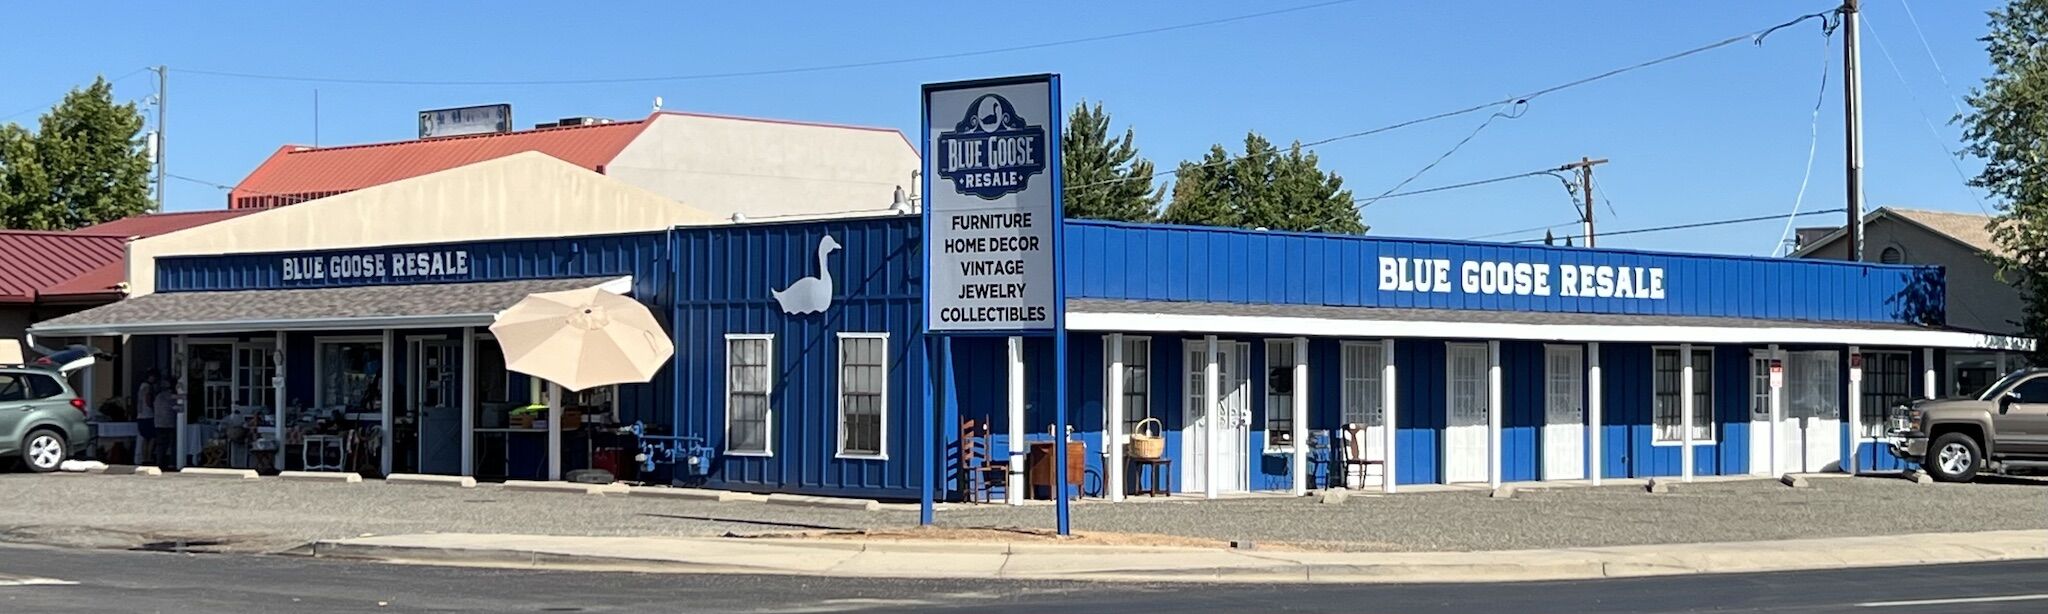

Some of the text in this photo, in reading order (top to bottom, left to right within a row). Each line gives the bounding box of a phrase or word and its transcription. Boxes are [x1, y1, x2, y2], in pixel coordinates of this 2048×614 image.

[948, 136, 1034, 172] BLUE GOOSE
[965, 172, 1018, 188] RESALE
[952, 212, 1032, 230] FURNITURE
[944, 236, 1039, 253] HOME DECOR
[283, 250, 468, 280] BLUE GOOSE RESALE
[960, 260, 1024, 276] VINTAGE
[1378, 256, 1665, 300] BLUE GOOSE RESALE
[958, 283, 1026, 299] JEWELRY
[940, 306, 1046, 322] COLLECTIBLES
